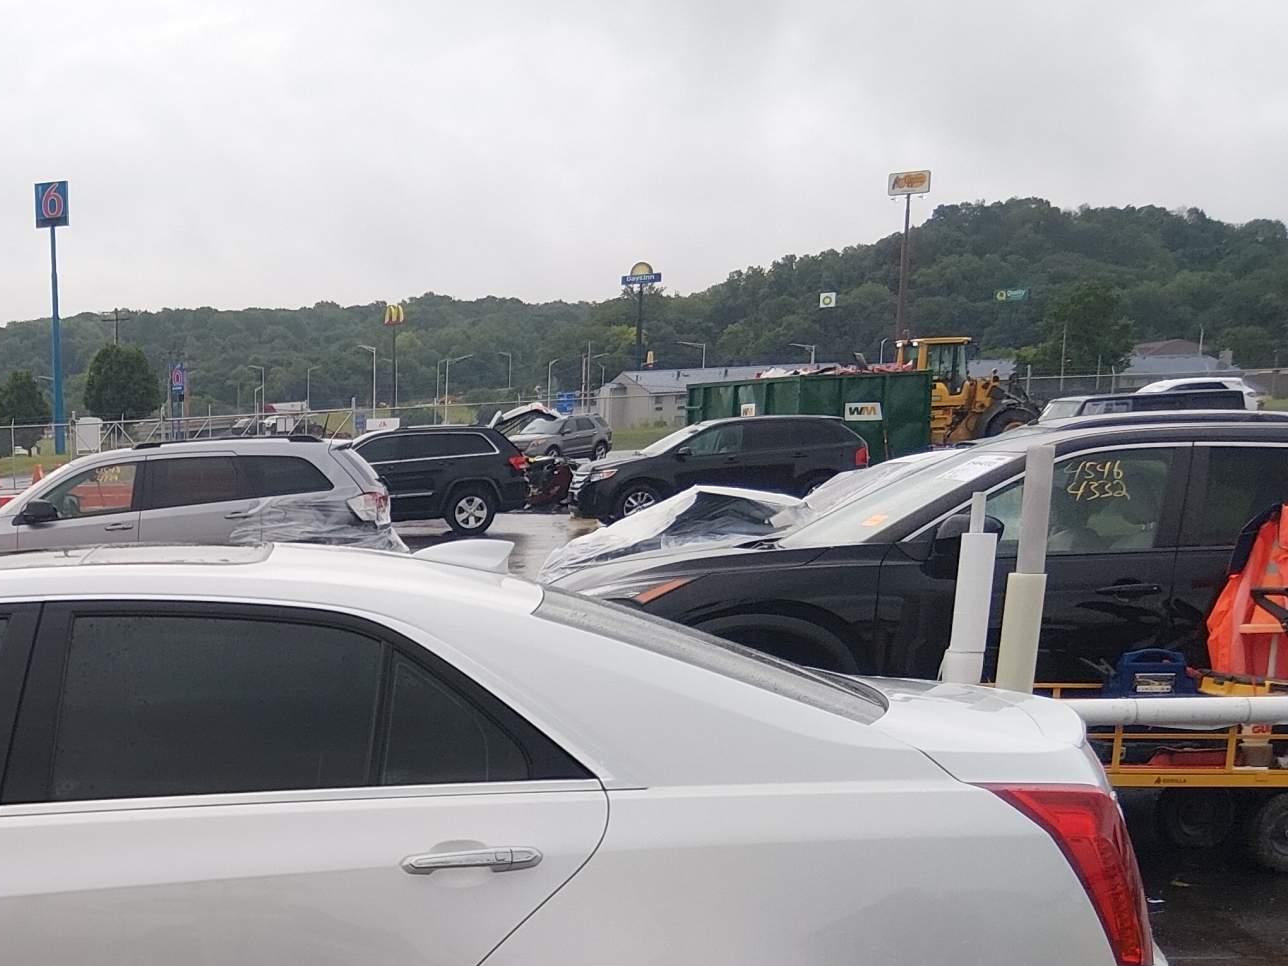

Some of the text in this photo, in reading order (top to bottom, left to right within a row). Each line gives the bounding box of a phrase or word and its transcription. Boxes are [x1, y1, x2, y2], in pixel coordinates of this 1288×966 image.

[42, 183, 64, 218] 6
[172, 368, 183, 385] 6
[848, 406, 877, 415] WM
[1063, 460, 1124, 480] 4546
[1067, 480, 1131, 501] 4332
